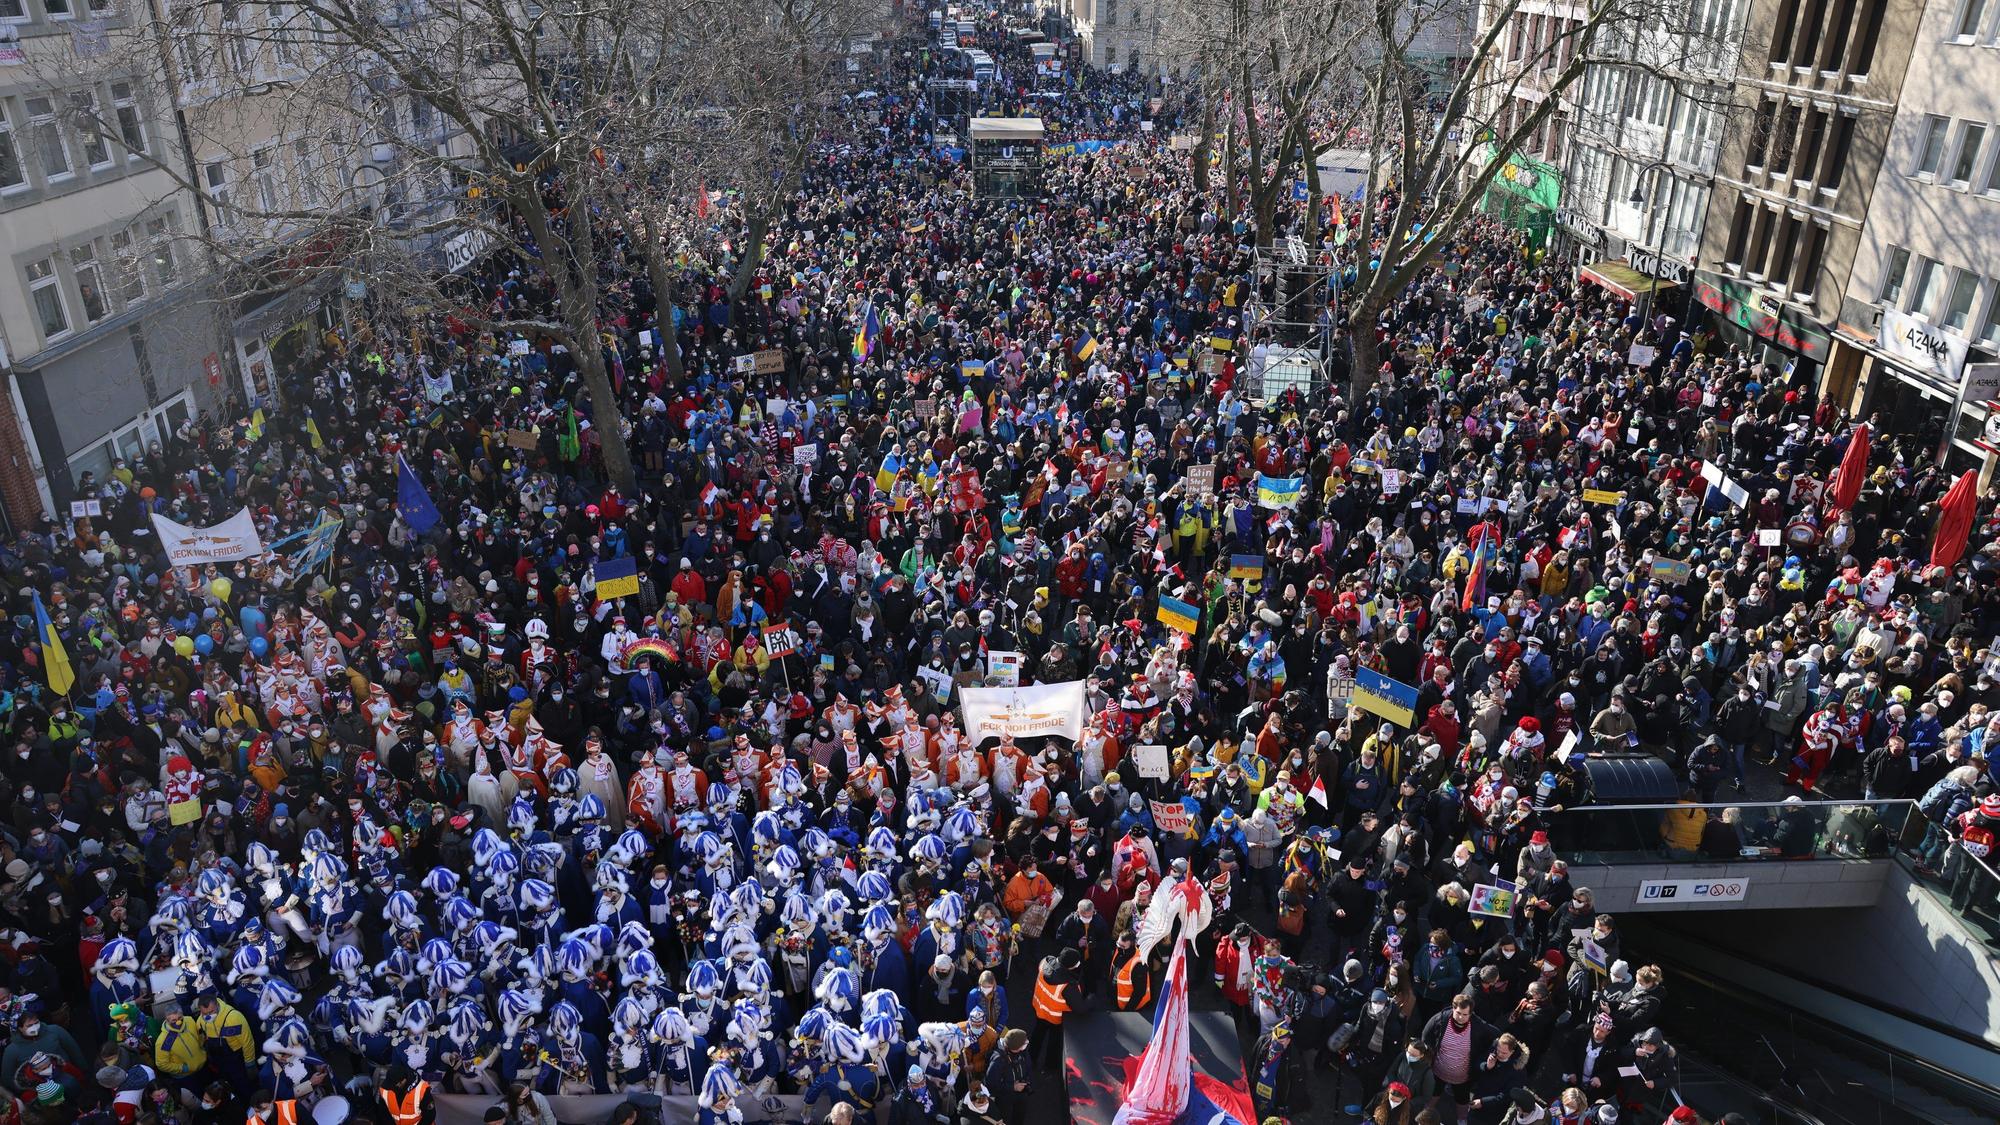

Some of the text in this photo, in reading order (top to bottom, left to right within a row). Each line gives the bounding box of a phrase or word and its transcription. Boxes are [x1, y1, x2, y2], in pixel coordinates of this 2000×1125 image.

[1003, 147, 1013, 159] U
[1048, 144, 1076, 156] WAR
[1632, 253, 1682, 281] KIOSK
[171, 549, 193, 560] JECK
[212, 544, 243, 556] FRIDDE
[769, 629, 788, 643] FCK
[771, 640, 790, 653] PTN
[979, 717, 1065, 732] JECK NOH FRIDDE
[1152, 802, 1184, 815] STOP
[1154, 813, 1188, 828] PUTIN
[1645, 886, 1674, 899] U 17
[1488, 897, 1506, 906] NOT
